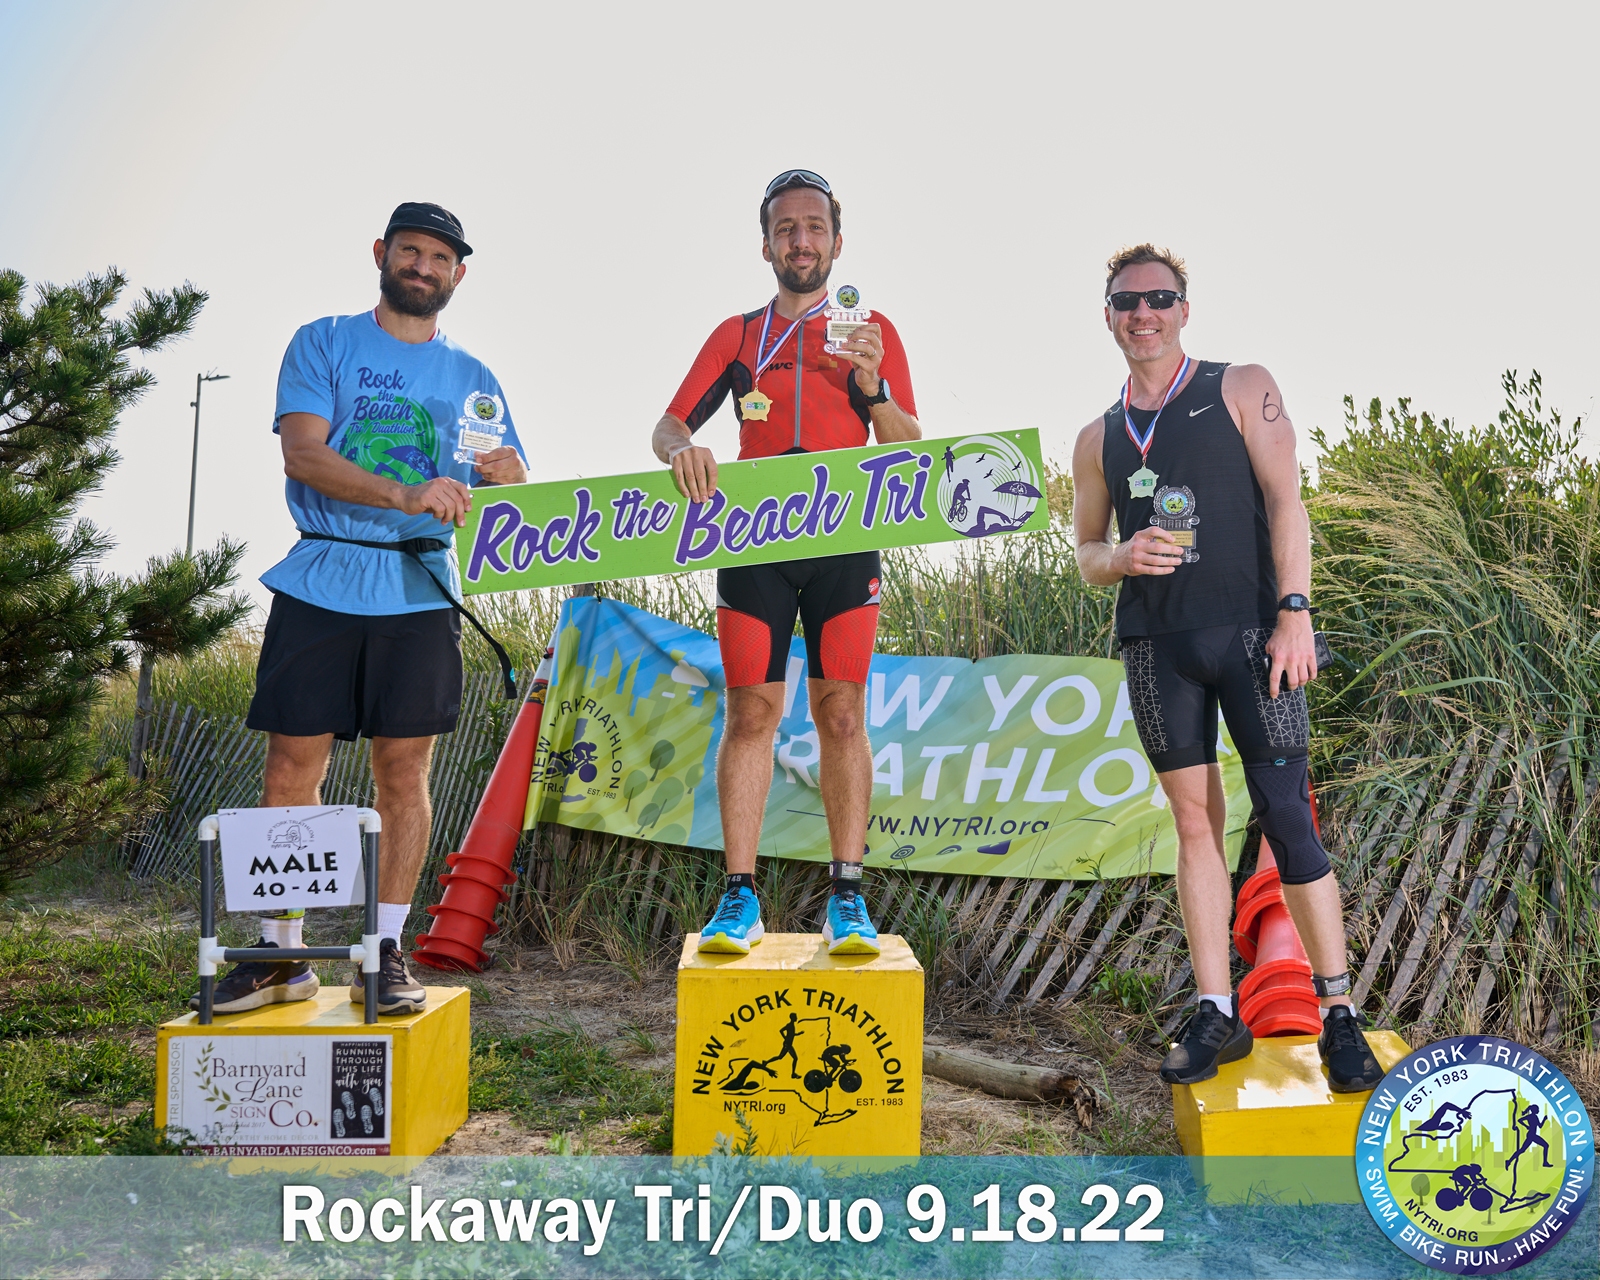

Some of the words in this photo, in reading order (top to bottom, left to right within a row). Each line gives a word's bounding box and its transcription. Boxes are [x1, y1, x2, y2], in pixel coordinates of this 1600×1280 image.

[357, 367, 406, 390] Rock
[377, 389, 395, 402] the
[353, 395, 415, 421] Beach
[465, 488, 601, 582] Rock
[612, 489, 677, 539] the
[675, 465, 853, 565] Beach
[859, 450, 932, 529] Tri
[531, 735, 552, 784] NEW
[583, 698, 623, 789] RIATHLON
[586, 787, 601, 797] EST.
[249, 851, 339, 876] MALE
[336, 1048, 382, 1056] RUNNING
[692, 1035, 725, 1095] NEW
[721, 988, 792, 1032] YORK
[802, 988, 905, 1094] TRIATHLON
[170, 1042, 181, 1100] SPONSOR
[212, 1056, 307, 1079] Barnyard
[336, 1056, 383, 1064] THROUGH
[336, 1065, 358, 1073] THIS
[361, 1065, 382, 1073] LIFE
[235, 1077, 303, 1103] Lane
[335, 1072, 359, 1089] with
[362, 1077, 383, 1095] you
[723, 1101, 786, 1114] NYTRI.org
[856, 1098, 878, 1106] EST.
[881, 1097, 903, 1106] 1983
[230, 1106, 267, 1118] SIGN
[269, 1100, 319, 1128] Co.
